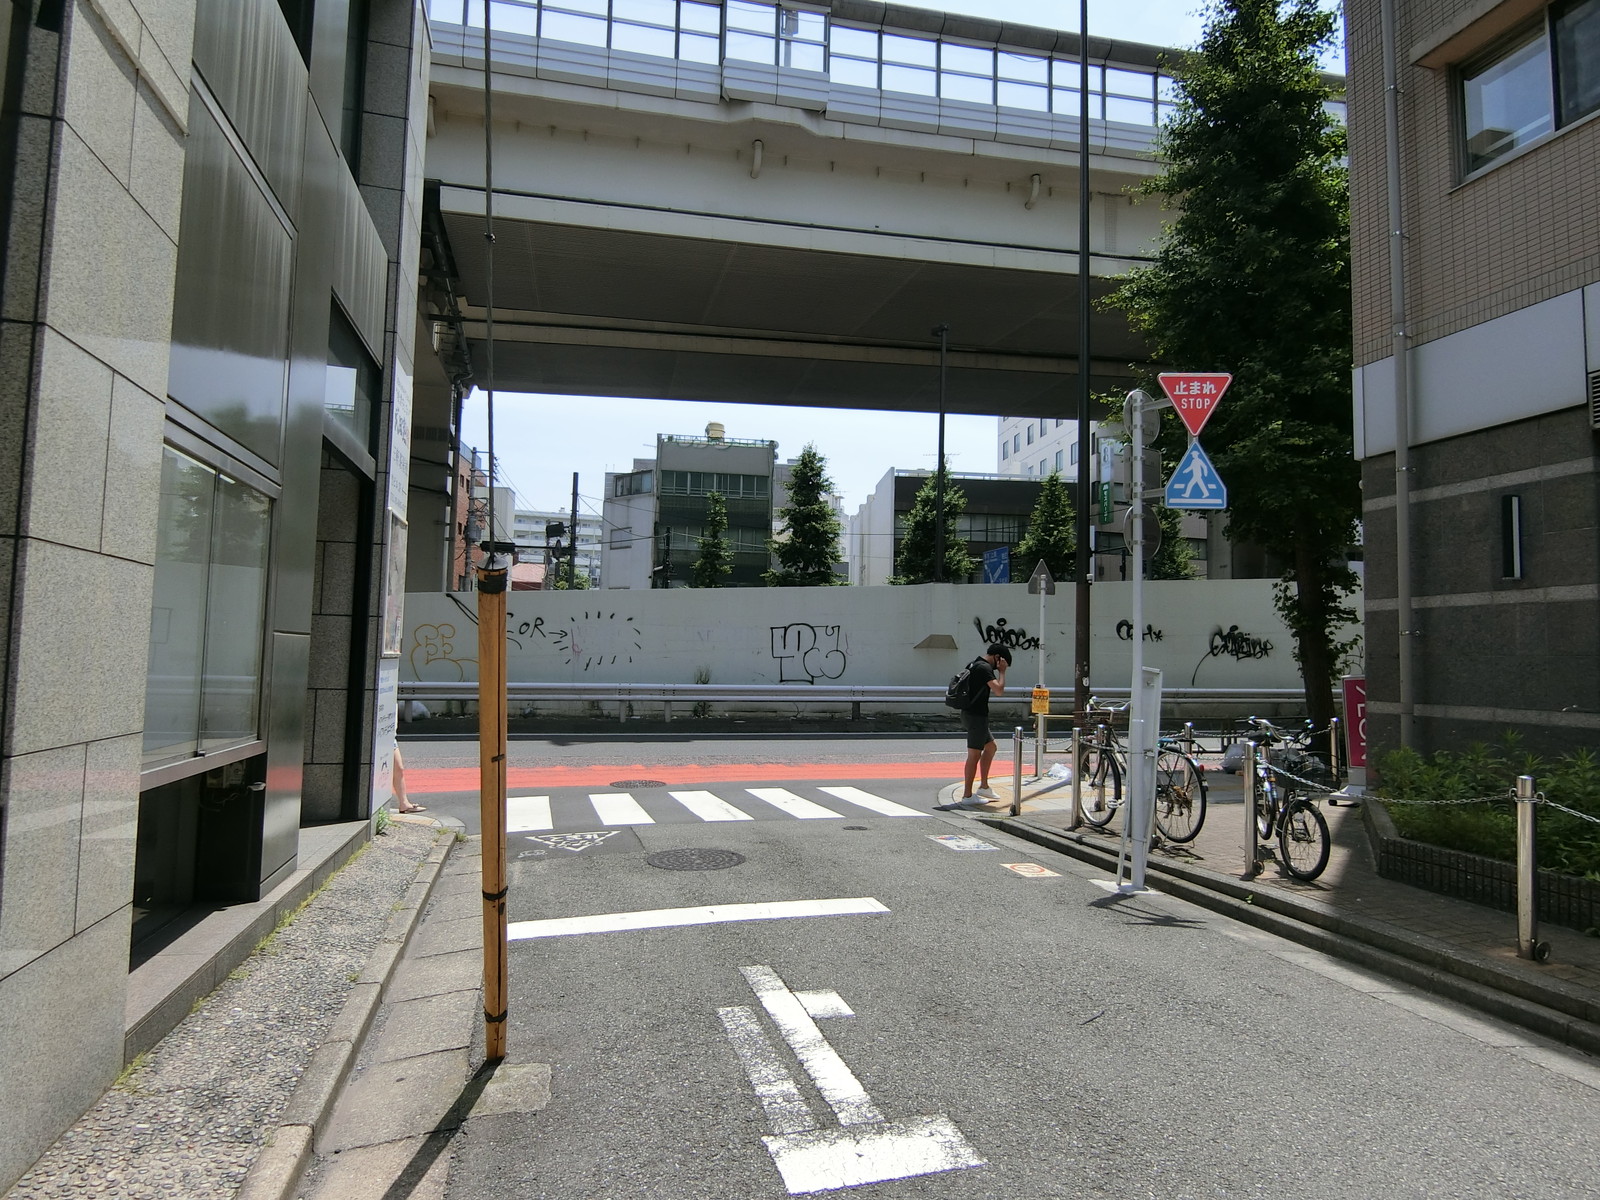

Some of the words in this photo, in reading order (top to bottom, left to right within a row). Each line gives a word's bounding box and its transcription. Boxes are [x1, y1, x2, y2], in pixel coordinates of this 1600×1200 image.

[1173, 381, 1217, 395] 止まれ
[1181, 398, 1211, 409] STOP
